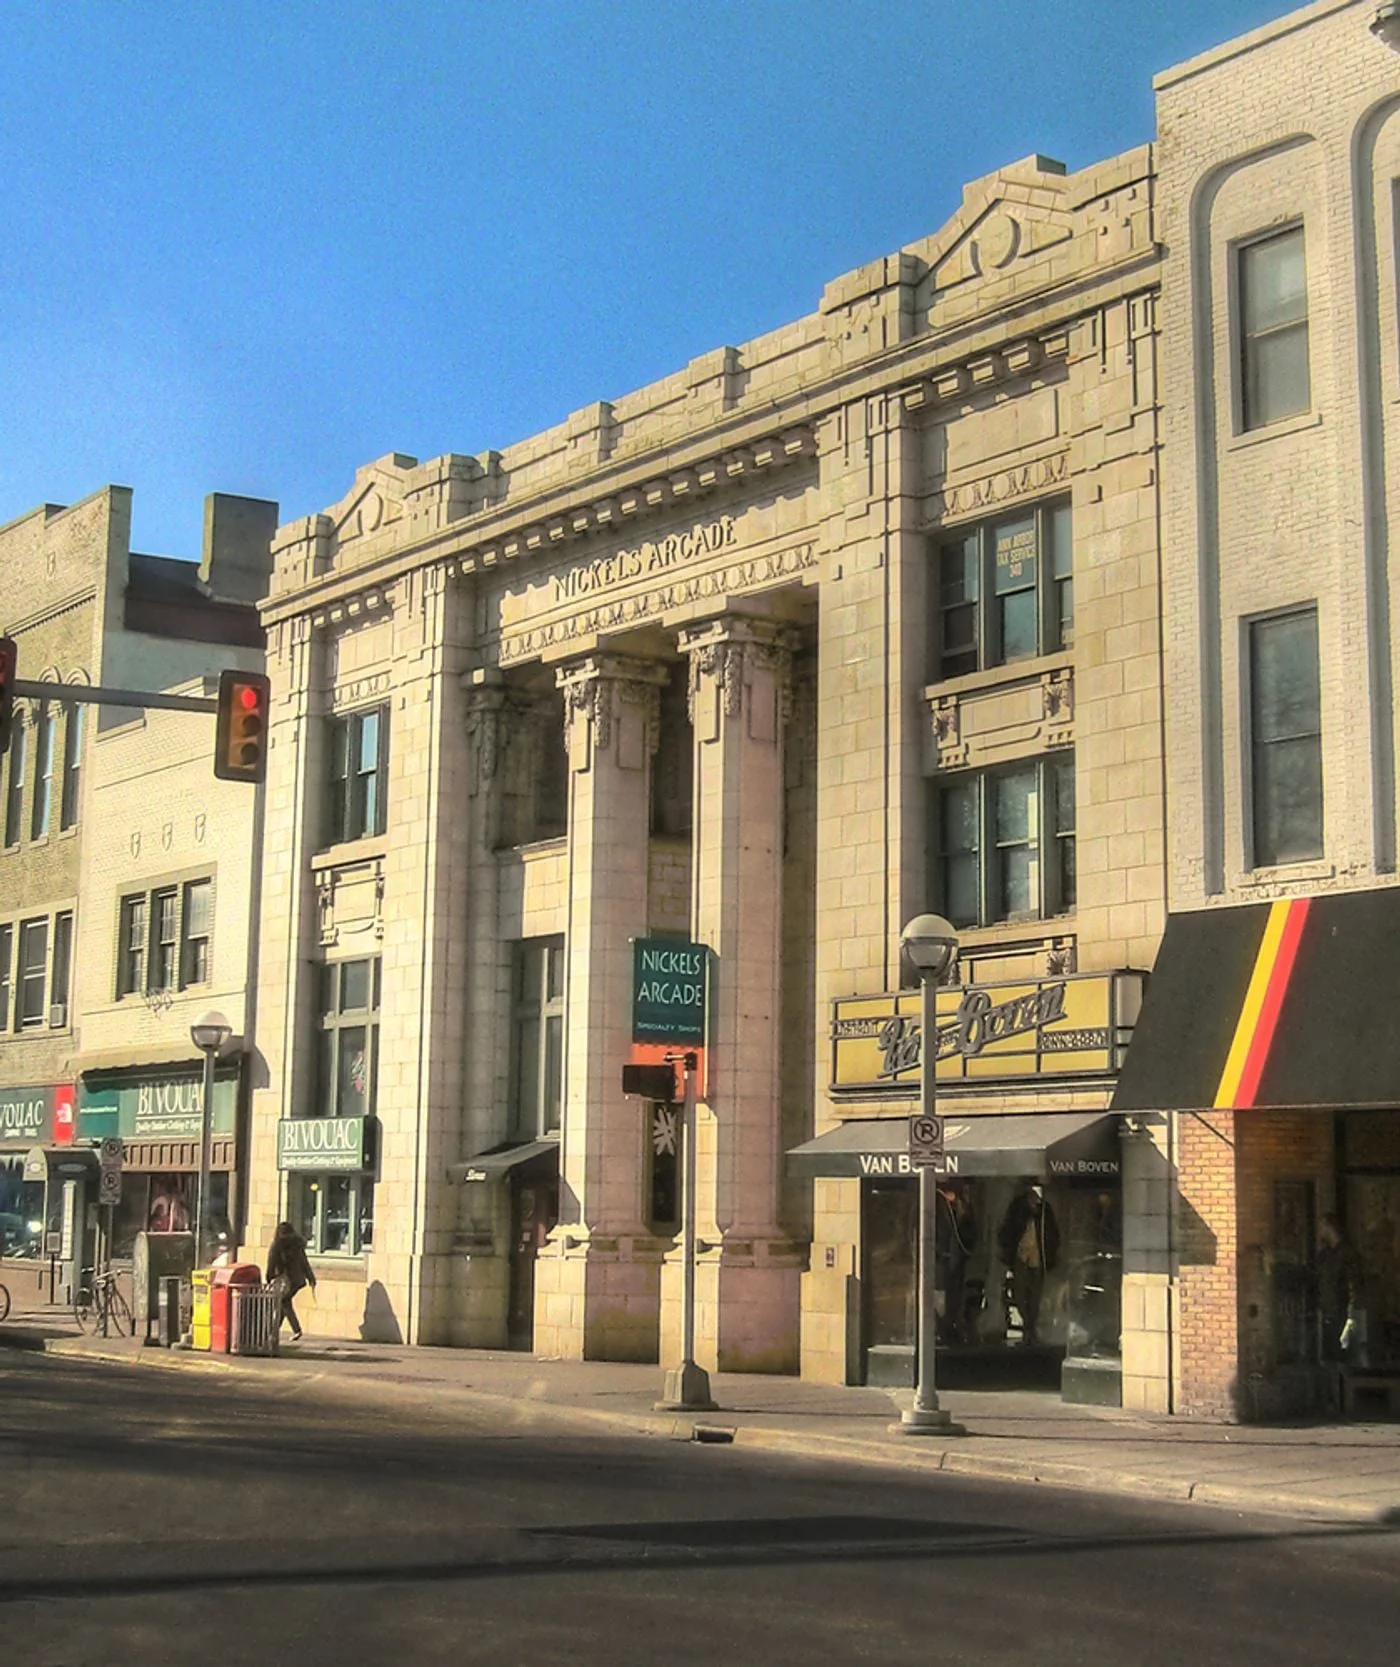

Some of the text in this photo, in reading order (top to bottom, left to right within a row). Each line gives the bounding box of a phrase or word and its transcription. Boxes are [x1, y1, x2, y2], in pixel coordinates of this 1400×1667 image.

[554, 520, 738, 601] NICKELS ARCADE
[641, 949, 701, 976] NICKELS
[638, 980, 703, 1007] ARCADE
[878, 982, 1067, 1075] Va Boven
[137, 1078, 206, 1115] BIVOUA
[283, 1118, 358, 1150] BIVOUAC
[860, 1155, 893, 1174] VAN
[1050, 1159, 1119, 1173] VAN BOVEN
